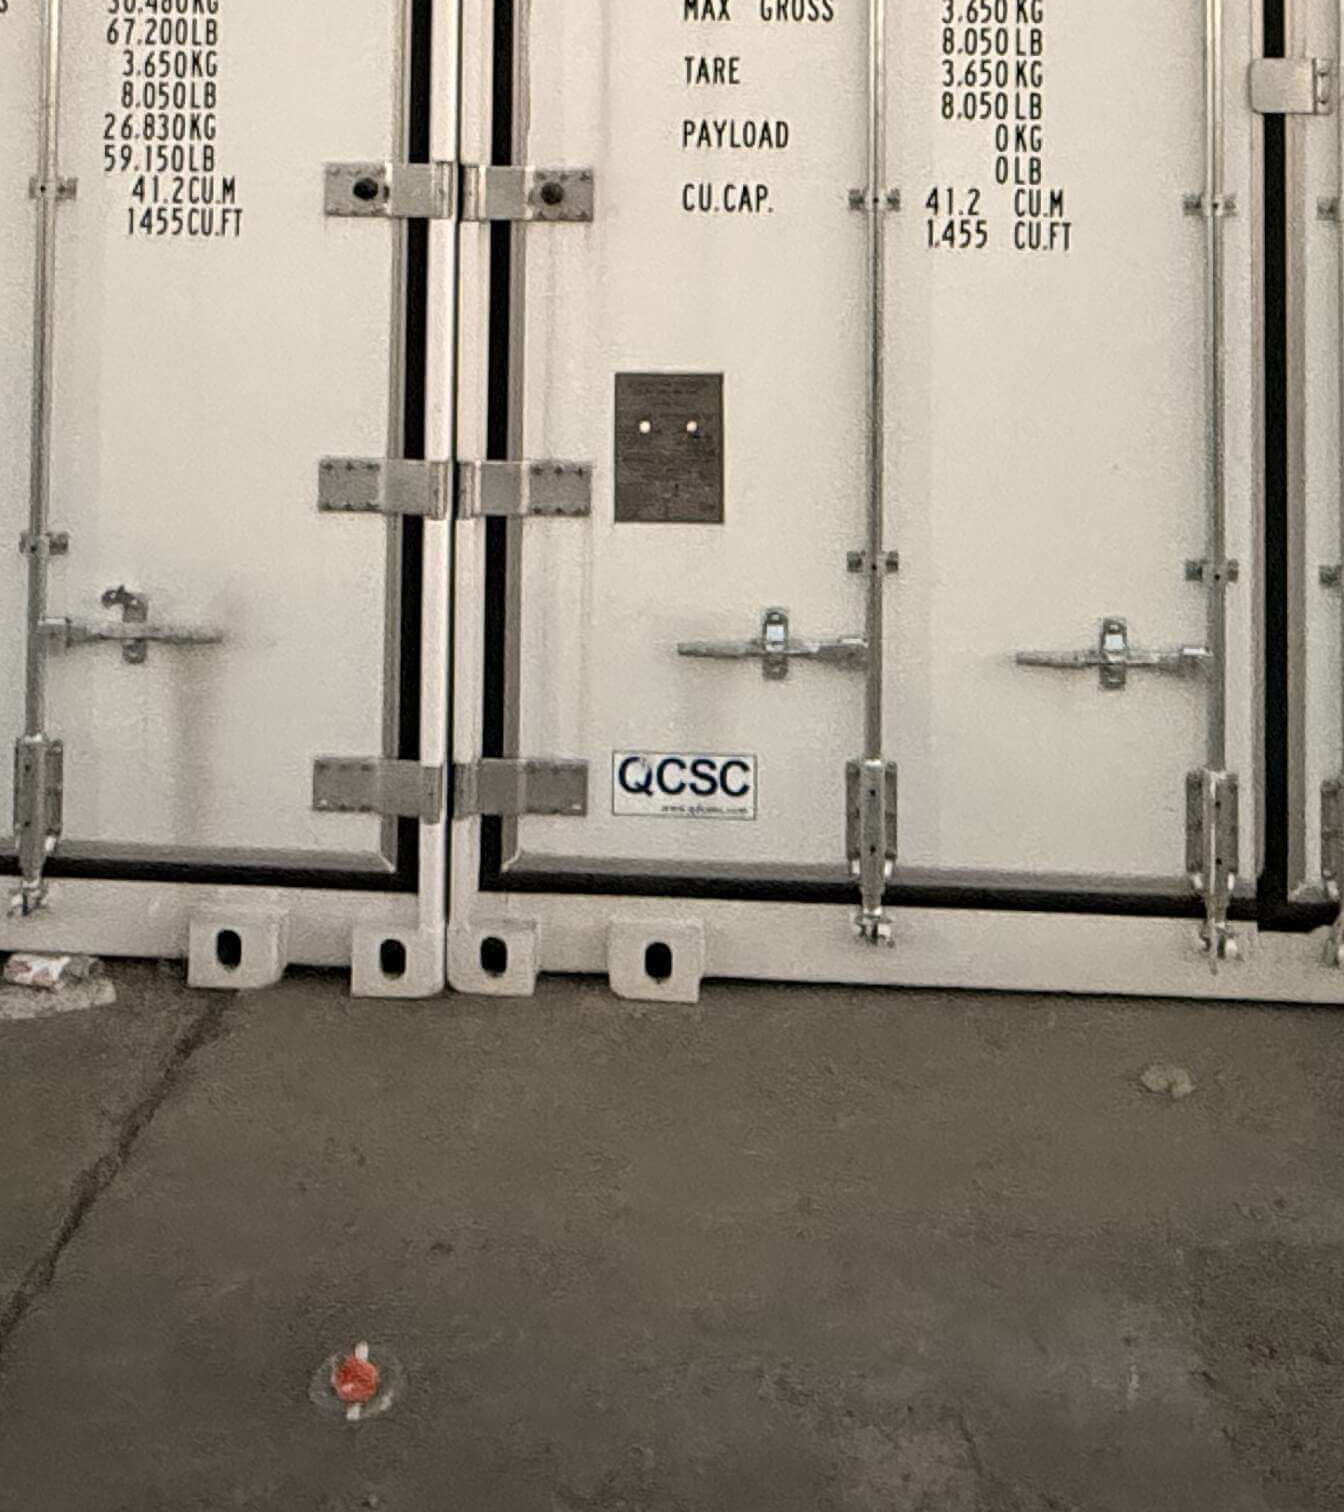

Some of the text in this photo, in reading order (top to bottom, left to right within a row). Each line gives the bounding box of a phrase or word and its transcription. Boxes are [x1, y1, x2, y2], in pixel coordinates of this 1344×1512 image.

[685, 57, 739, 84] TARE
[683, 119, 788, 148] PAYLOAD
[683, 183, 1063, 217] CU.CAP. 41.2 CU.M
[928, 219, 1071, 251] 1.455 CU.FT
[619, 756, 750, 797] QCSC
